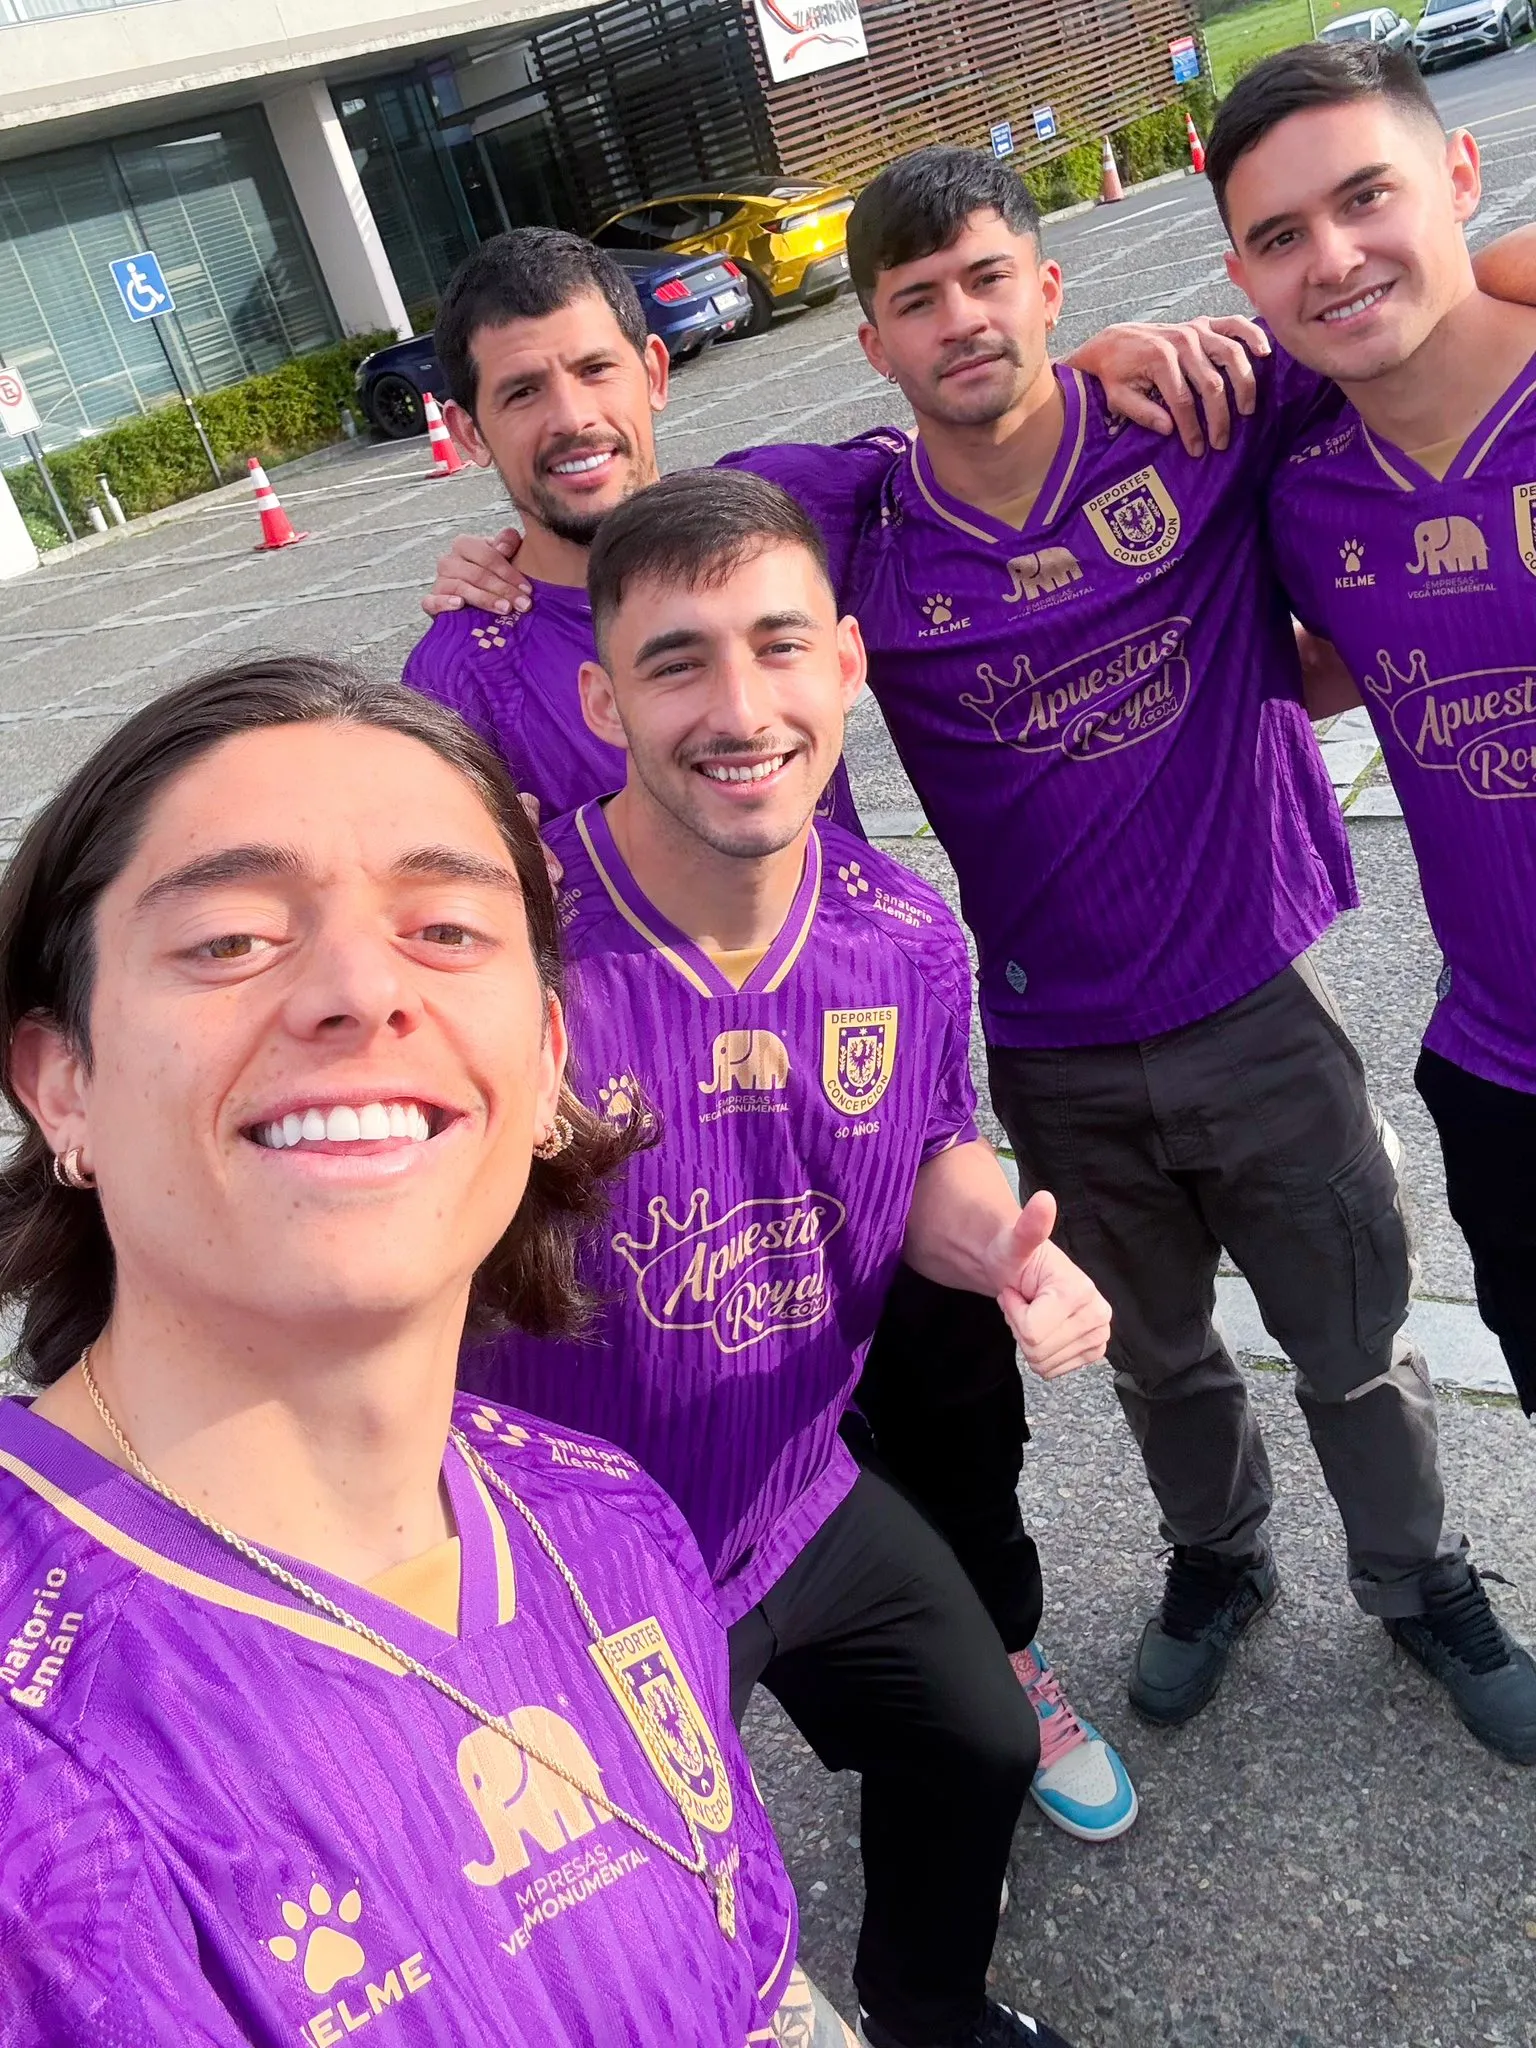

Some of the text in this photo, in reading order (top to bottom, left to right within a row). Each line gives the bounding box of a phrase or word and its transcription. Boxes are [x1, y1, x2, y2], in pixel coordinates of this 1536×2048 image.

[1089, 470, 1151, 512] DEPORTES
[1113, 517, 1178, 563] CONCEPCION
[1135, 571, 1152, 585] 60
[1335, 574, 1376, 589] KELME
[1407, 583, 1496, 600] VEGA MONUMENTAL
[918, 616, 972, 638] KELME
[1017, 629, 1178, 743] Apuestas
[1415, 676, 1536, 755] Apuest
[872, 898, 920, 928] Alemán
[874, 887, 933, 924] Sanatorio
[831, 1010, 892, 1024] DEPORTES
[717, 1095, 771, 1109] EMPRESAS
[827, 1074, 888, 1111] CONCEPCION
[699, 1102, 789, 1123] VEGA MONUMENTAL
[834, 1120, 880, 1138] 60 AÑOS
[726, 1272, 825, 1340] Royal
[538, 1432, 640, 1472] Sanatorio
[551, 1445, 630, 1481] Alemán
[0, 1567, 67, 1685] natorio
[606, 1623, 662, 1663] EPORTES
[514, 1843, 608, 1910] MPRESAS
[523, 1847, 650, 1931] MONUMENTAL
